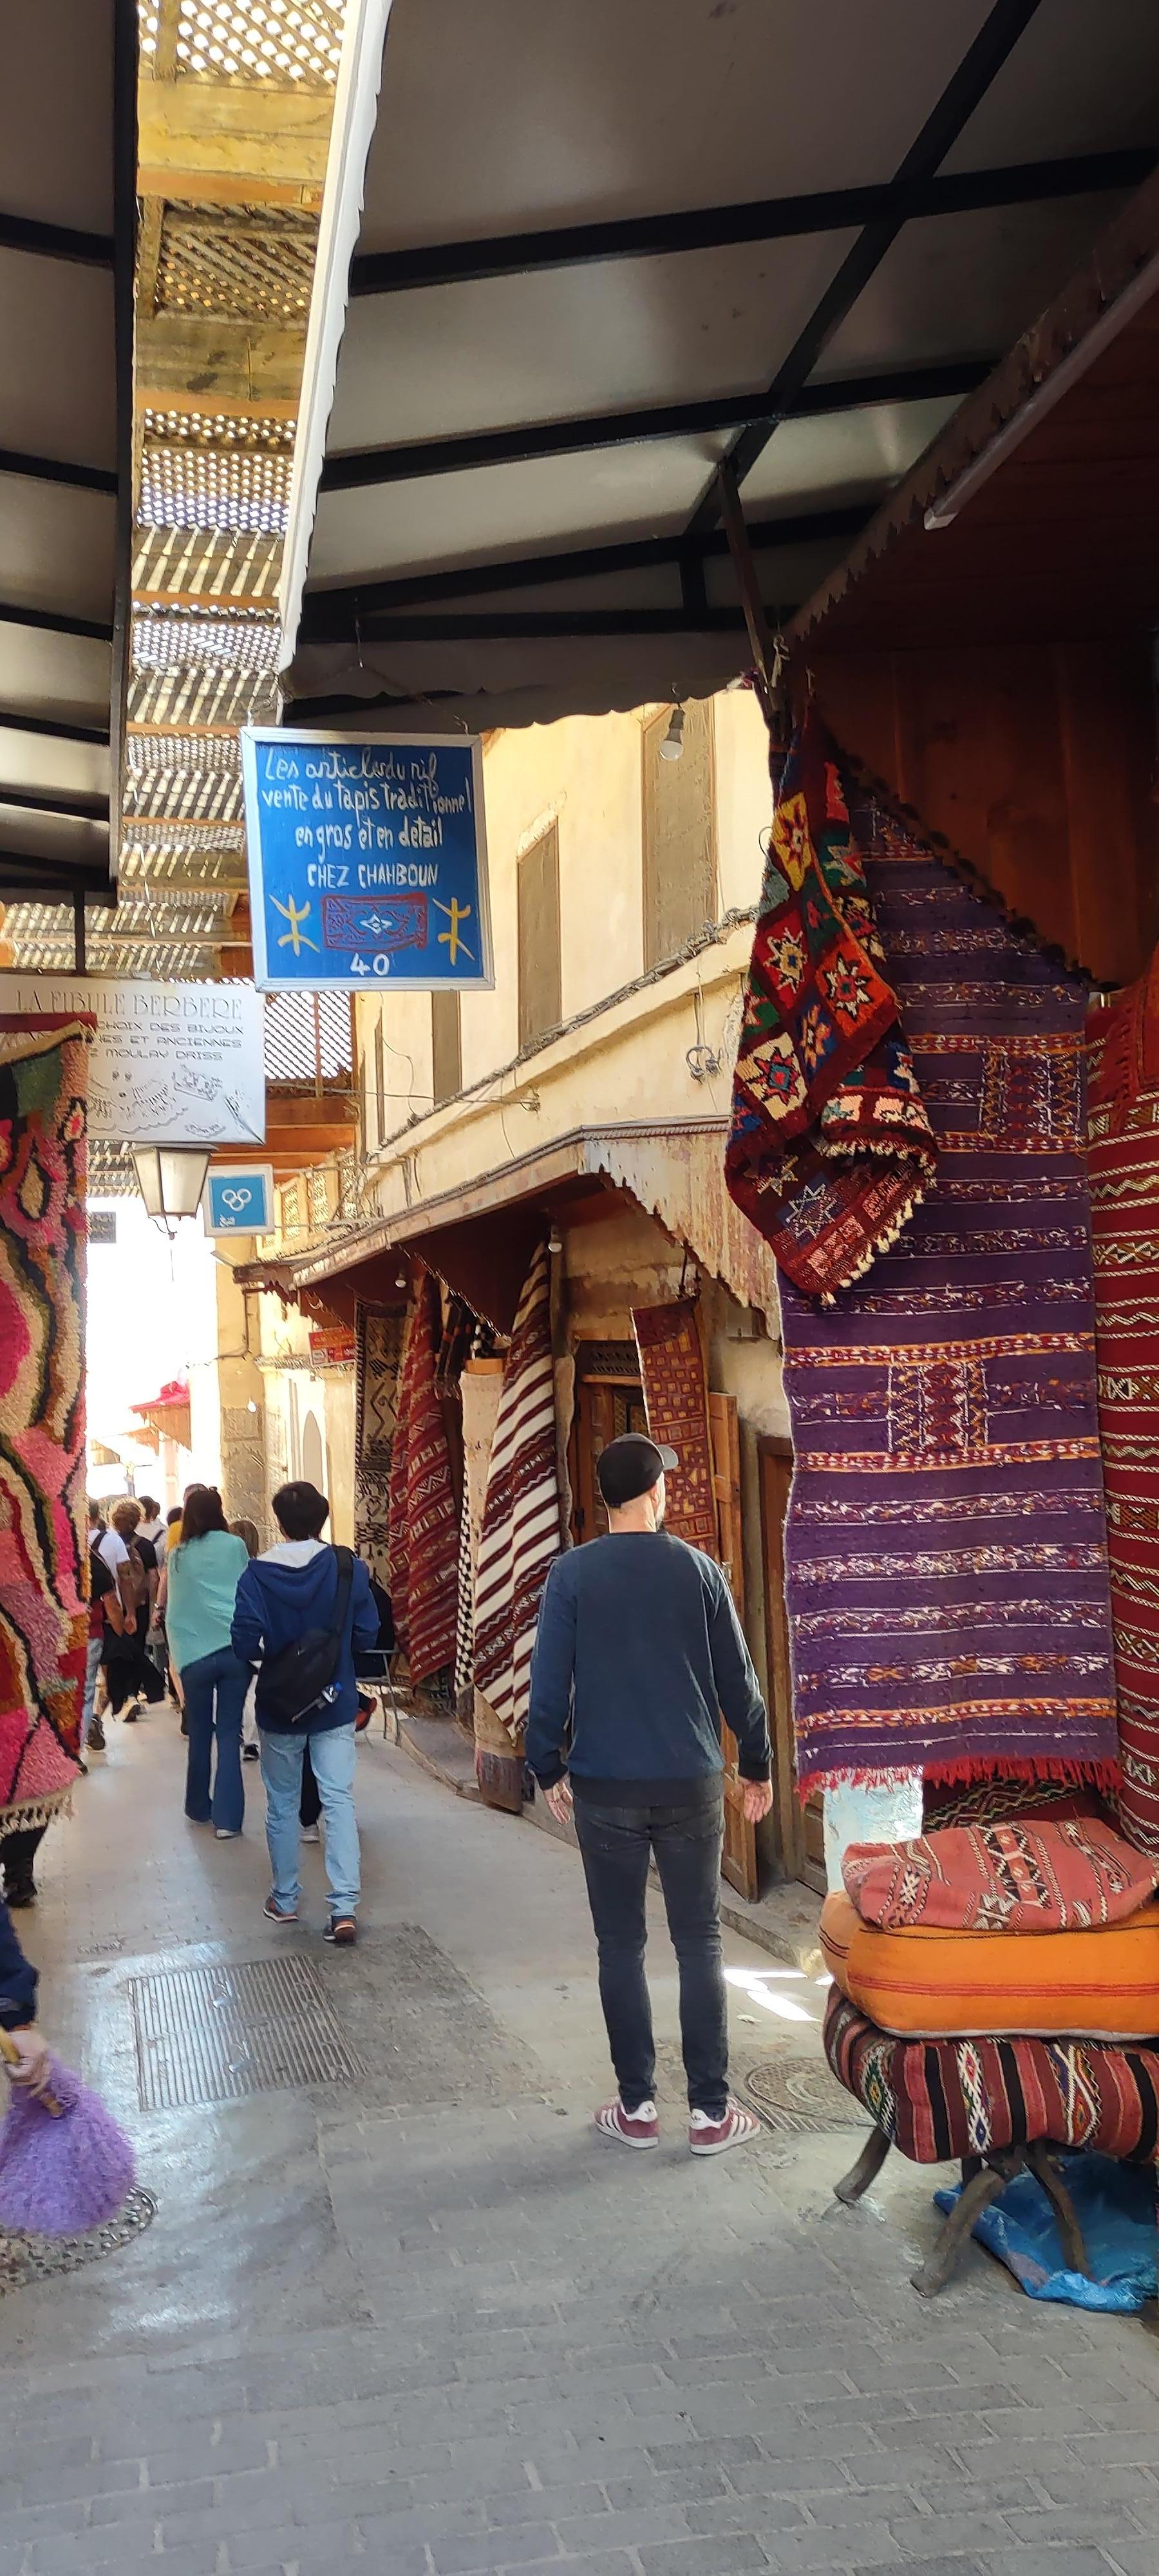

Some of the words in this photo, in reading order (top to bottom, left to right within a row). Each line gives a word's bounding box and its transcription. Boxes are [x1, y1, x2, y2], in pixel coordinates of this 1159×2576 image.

[265, 747, 299, 780] Les
[410, 752, 439, 800] rif
[262, 783, 309, 811] vente
[312, 782, 334, 810] du
[333, 779, 380, 828] tapis
[295, 824, 313, 848] en
[316, 824, 353, 864] gros
[357, 816, 376, 850] et
[377, 826, 393, 850] en
[399, 815, 443, 849] detail
[307, 863, 351, 889] CHEZ
[357, 863, 440, 889] CHAHBOUN
[350, 953, 390, 976] 40
[17, 990, 42, 1012] LA
[51, 990, 126, 1016] FIBULE
[133, 994, 242, 1020] BERBERE
[130, 1035, 149, 1045] ET
[156, 1036, 243, 1048] ANCIENNES
[149, 1022, 181, 1033] DES
[187, 1024, 245, 1035] BIJOUX
[106, 1048, 169, 1059] MOULAY
[176, 1050, 223, 1061] DRISS
